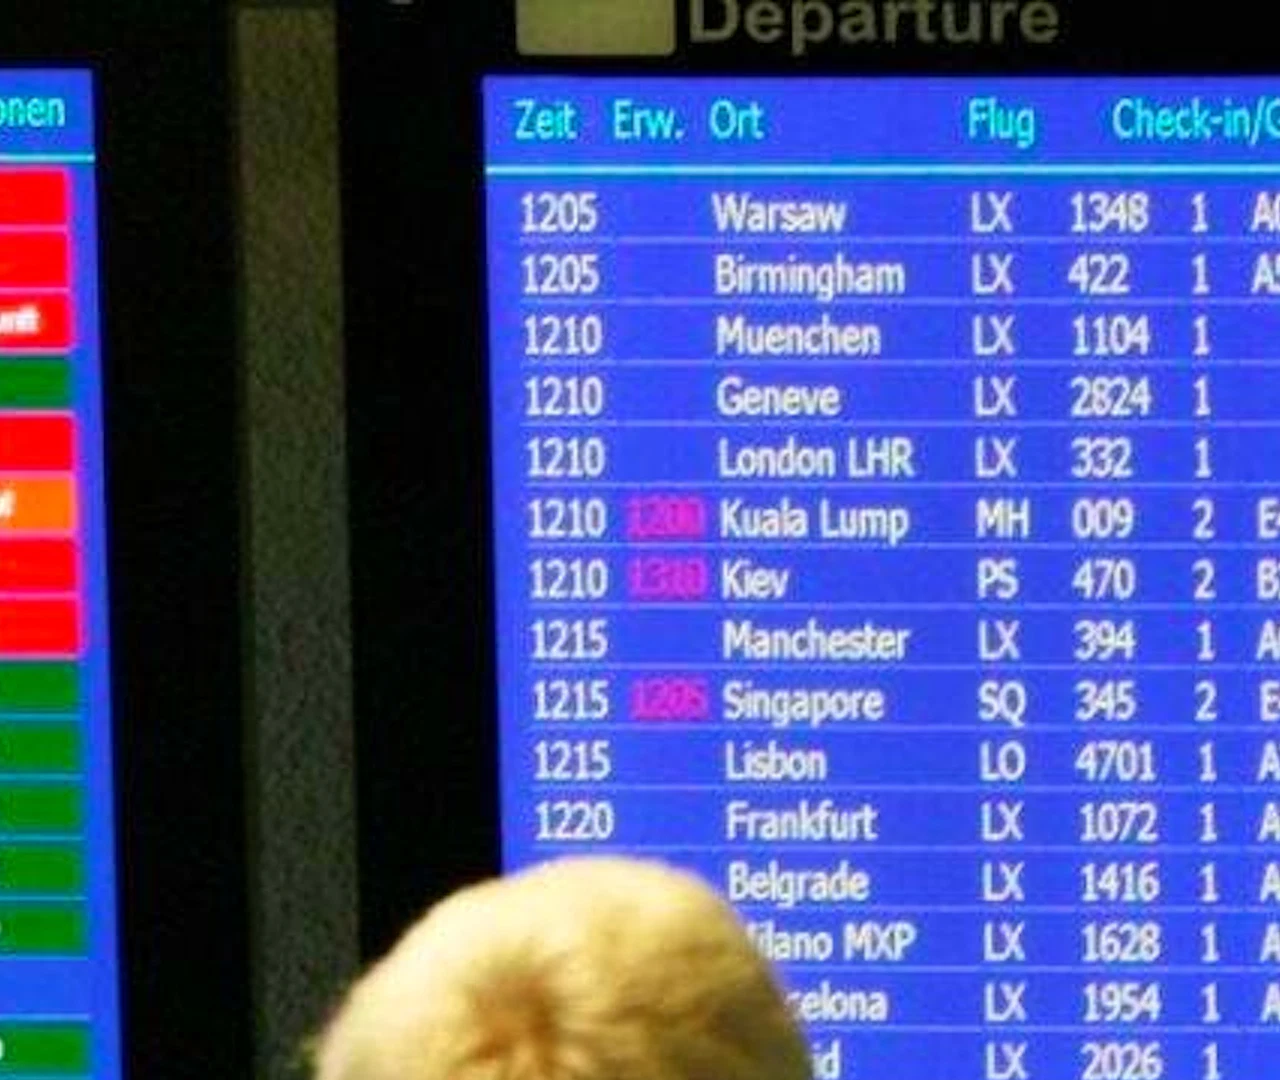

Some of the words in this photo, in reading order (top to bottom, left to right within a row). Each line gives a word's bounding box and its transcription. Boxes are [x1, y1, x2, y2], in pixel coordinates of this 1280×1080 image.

[689, 0, 1060, 56] Departure
[515, 99, 577, 140] Zeit
[613, 99, 683, 139] Erw.
[709, 99, 763, 139] Ort
[969, 98, 1035, 148] Flug
[522, 192, 597, 233] 1205
[712, 193, 846, 232] Warsaw
[972, 193, 1012, 232] LX
[1072, 192, 1148, 232] 1348
[1192, 193, 1208, 232] 1
[523, 254, 599, 294] 1205
[716, 253, 905, 303] Birmingham
[973, 254, 1013, 294] LX
[1068, 254, 1129, 294] 422
[1193, 255, 1208, 293] 1
[528, 437, 605, 477] 1210
[719, 436, 835, 477] London
[848, 437, 914, 477] LHR
[976, 438, 1016, 477] LX
[1072, 437, 1133, 478] 332
[1196, 439, 1211, 477] 1
[529, 498, 606, 538] 1210
[721, 497, 808, 538] Kuala
[820, 499, 909, 547] Lump
[977, 499, 1029, 537] MH
[1073, 499, 1134, 538] 009
[1194, 499, 1213, 538] 2
[532, 619, 608, 659] 1215
[723, 619, 910, 660] Manchester
[979, 621, 1019, 660] LX
[1075, 620, 1136, 660] 394
[1198, 622, 1213, 660] 1
[534, 680, 608, 720] 1215
[723, 680, 884, 729] Singapore
[979, 681, 1026, 729] SQ
[1076, 680, 1136, 721] 345
[1196, 681, 1216, 721] 2
